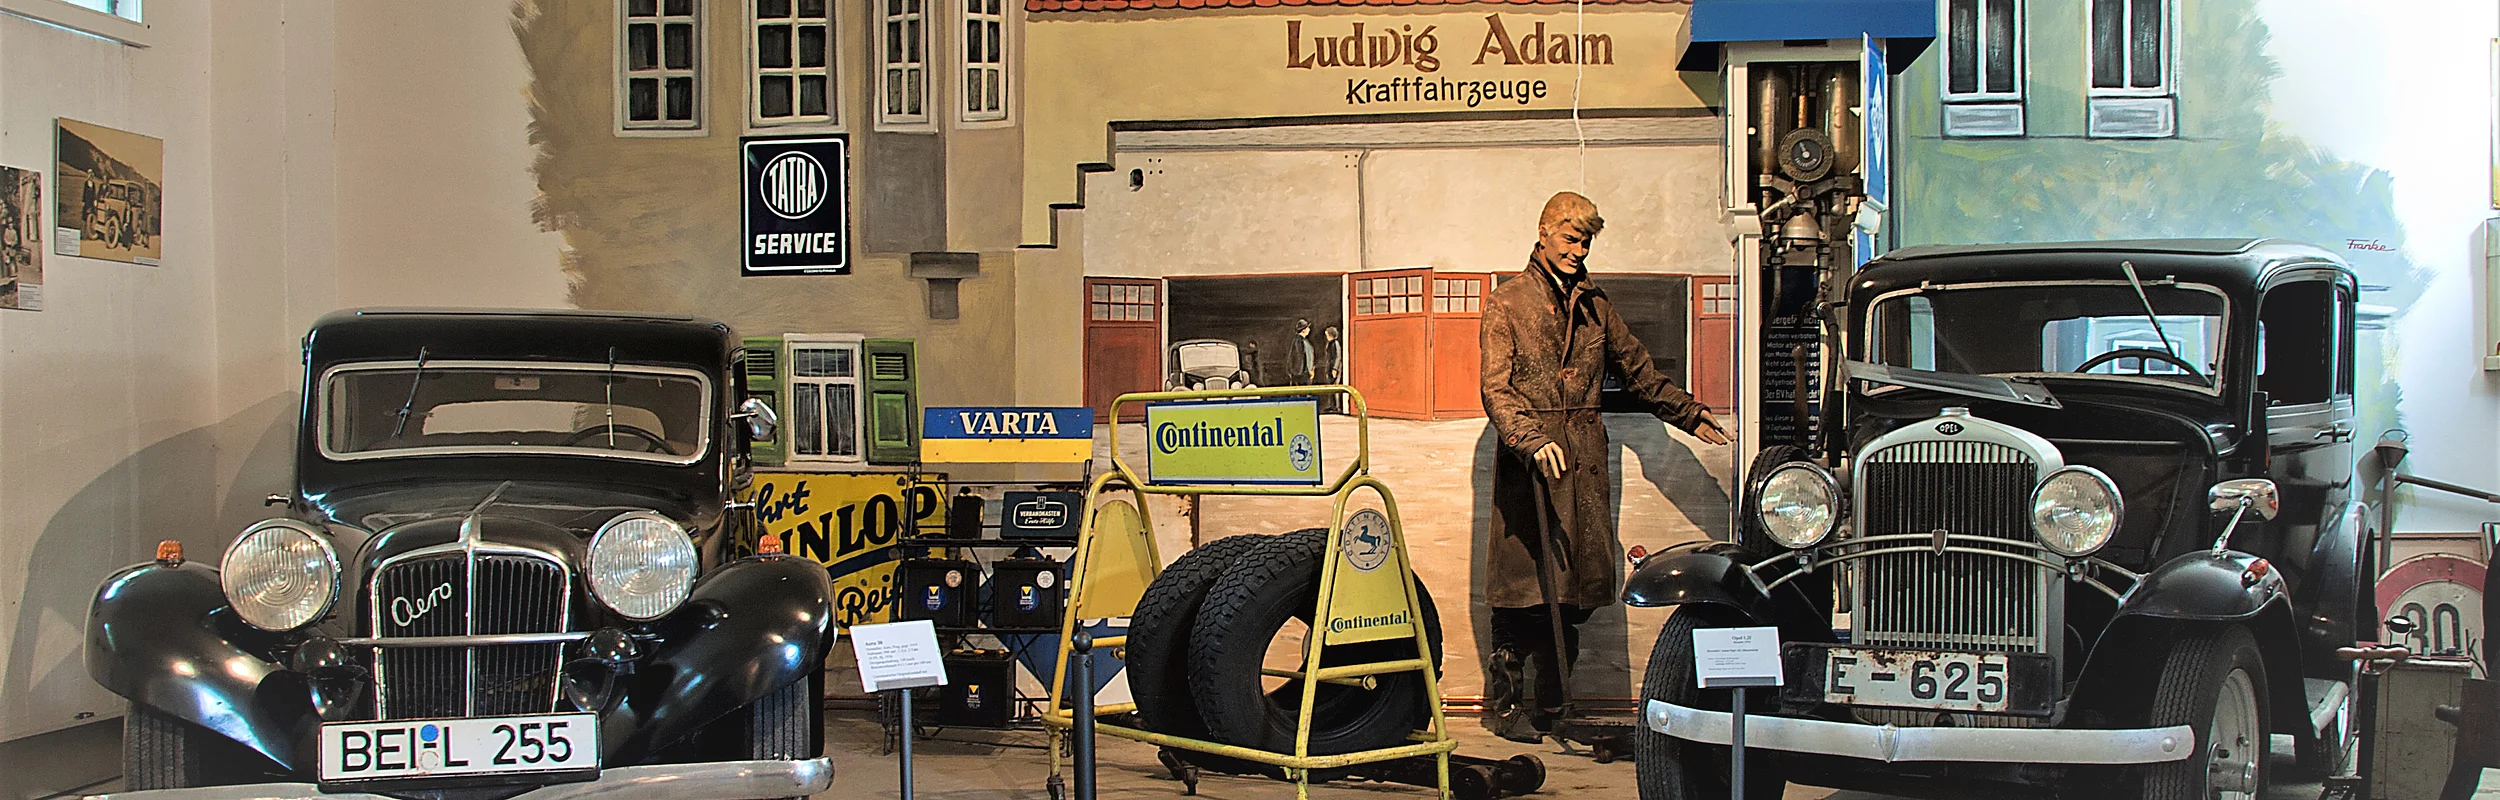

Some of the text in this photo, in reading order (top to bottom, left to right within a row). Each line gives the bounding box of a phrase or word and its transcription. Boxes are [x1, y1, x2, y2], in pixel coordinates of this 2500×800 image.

[1285, 12, 1614, 73] Ludwig Adam
[1345, 76, 1548, 108] Kraftfahrzeuge
[769, 156, 818, 213] TATRA
[754, 232, 836, 255] SERVICE
[2346, 239, 2396, 251] Franke
[959, 411, 1059, 435] VARTA
[1156, 417, 1285, 455] Continental
[1939, 423, 1959, 433] OPEL
[1344, 513, 1389, 557] CONTINENTAL
[391, 582, 452, 627] Aero
[1330, 610, 1408, 634] Continental
[491, 721, 574, 766] 255
